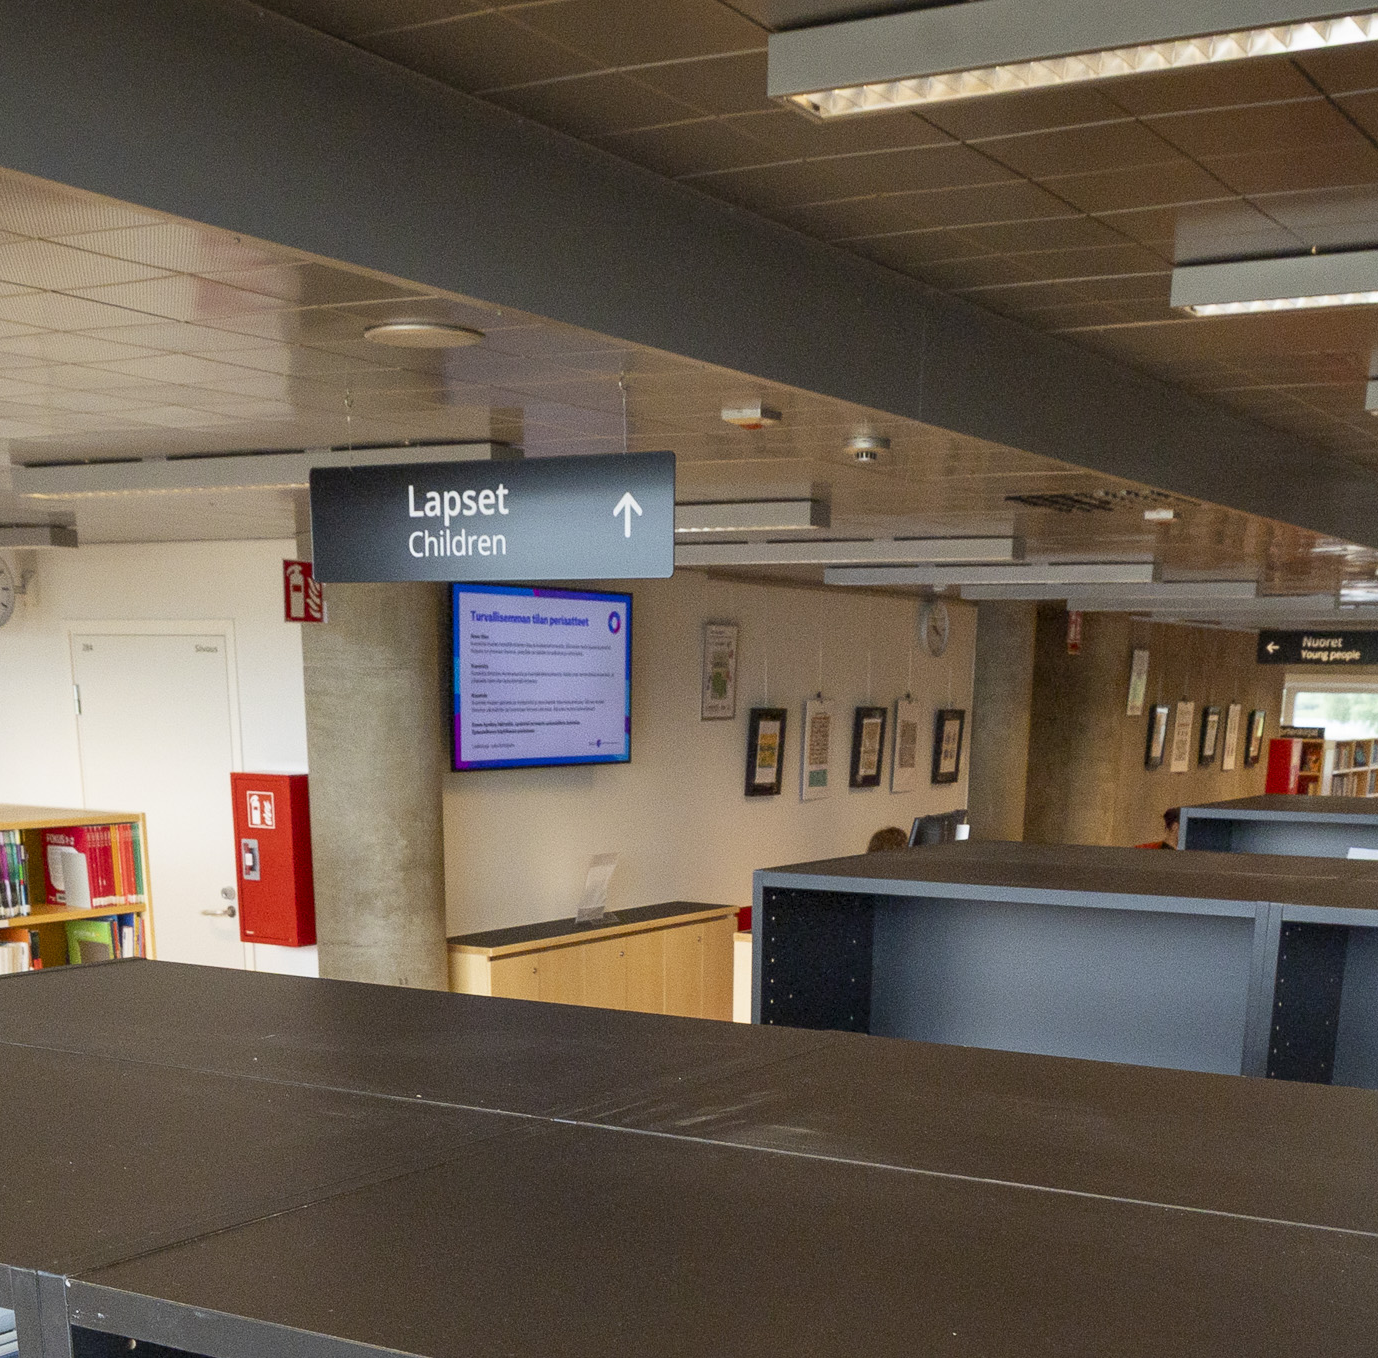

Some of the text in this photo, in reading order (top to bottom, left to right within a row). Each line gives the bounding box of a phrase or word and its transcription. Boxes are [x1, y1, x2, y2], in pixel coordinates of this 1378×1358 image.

[408, 483, 509, 526] Lapset
[409, 528, 506, 557] Children
[1302, 636, 1343, 647] Nuoret
[1301, 650, 1361, 661] Young people
